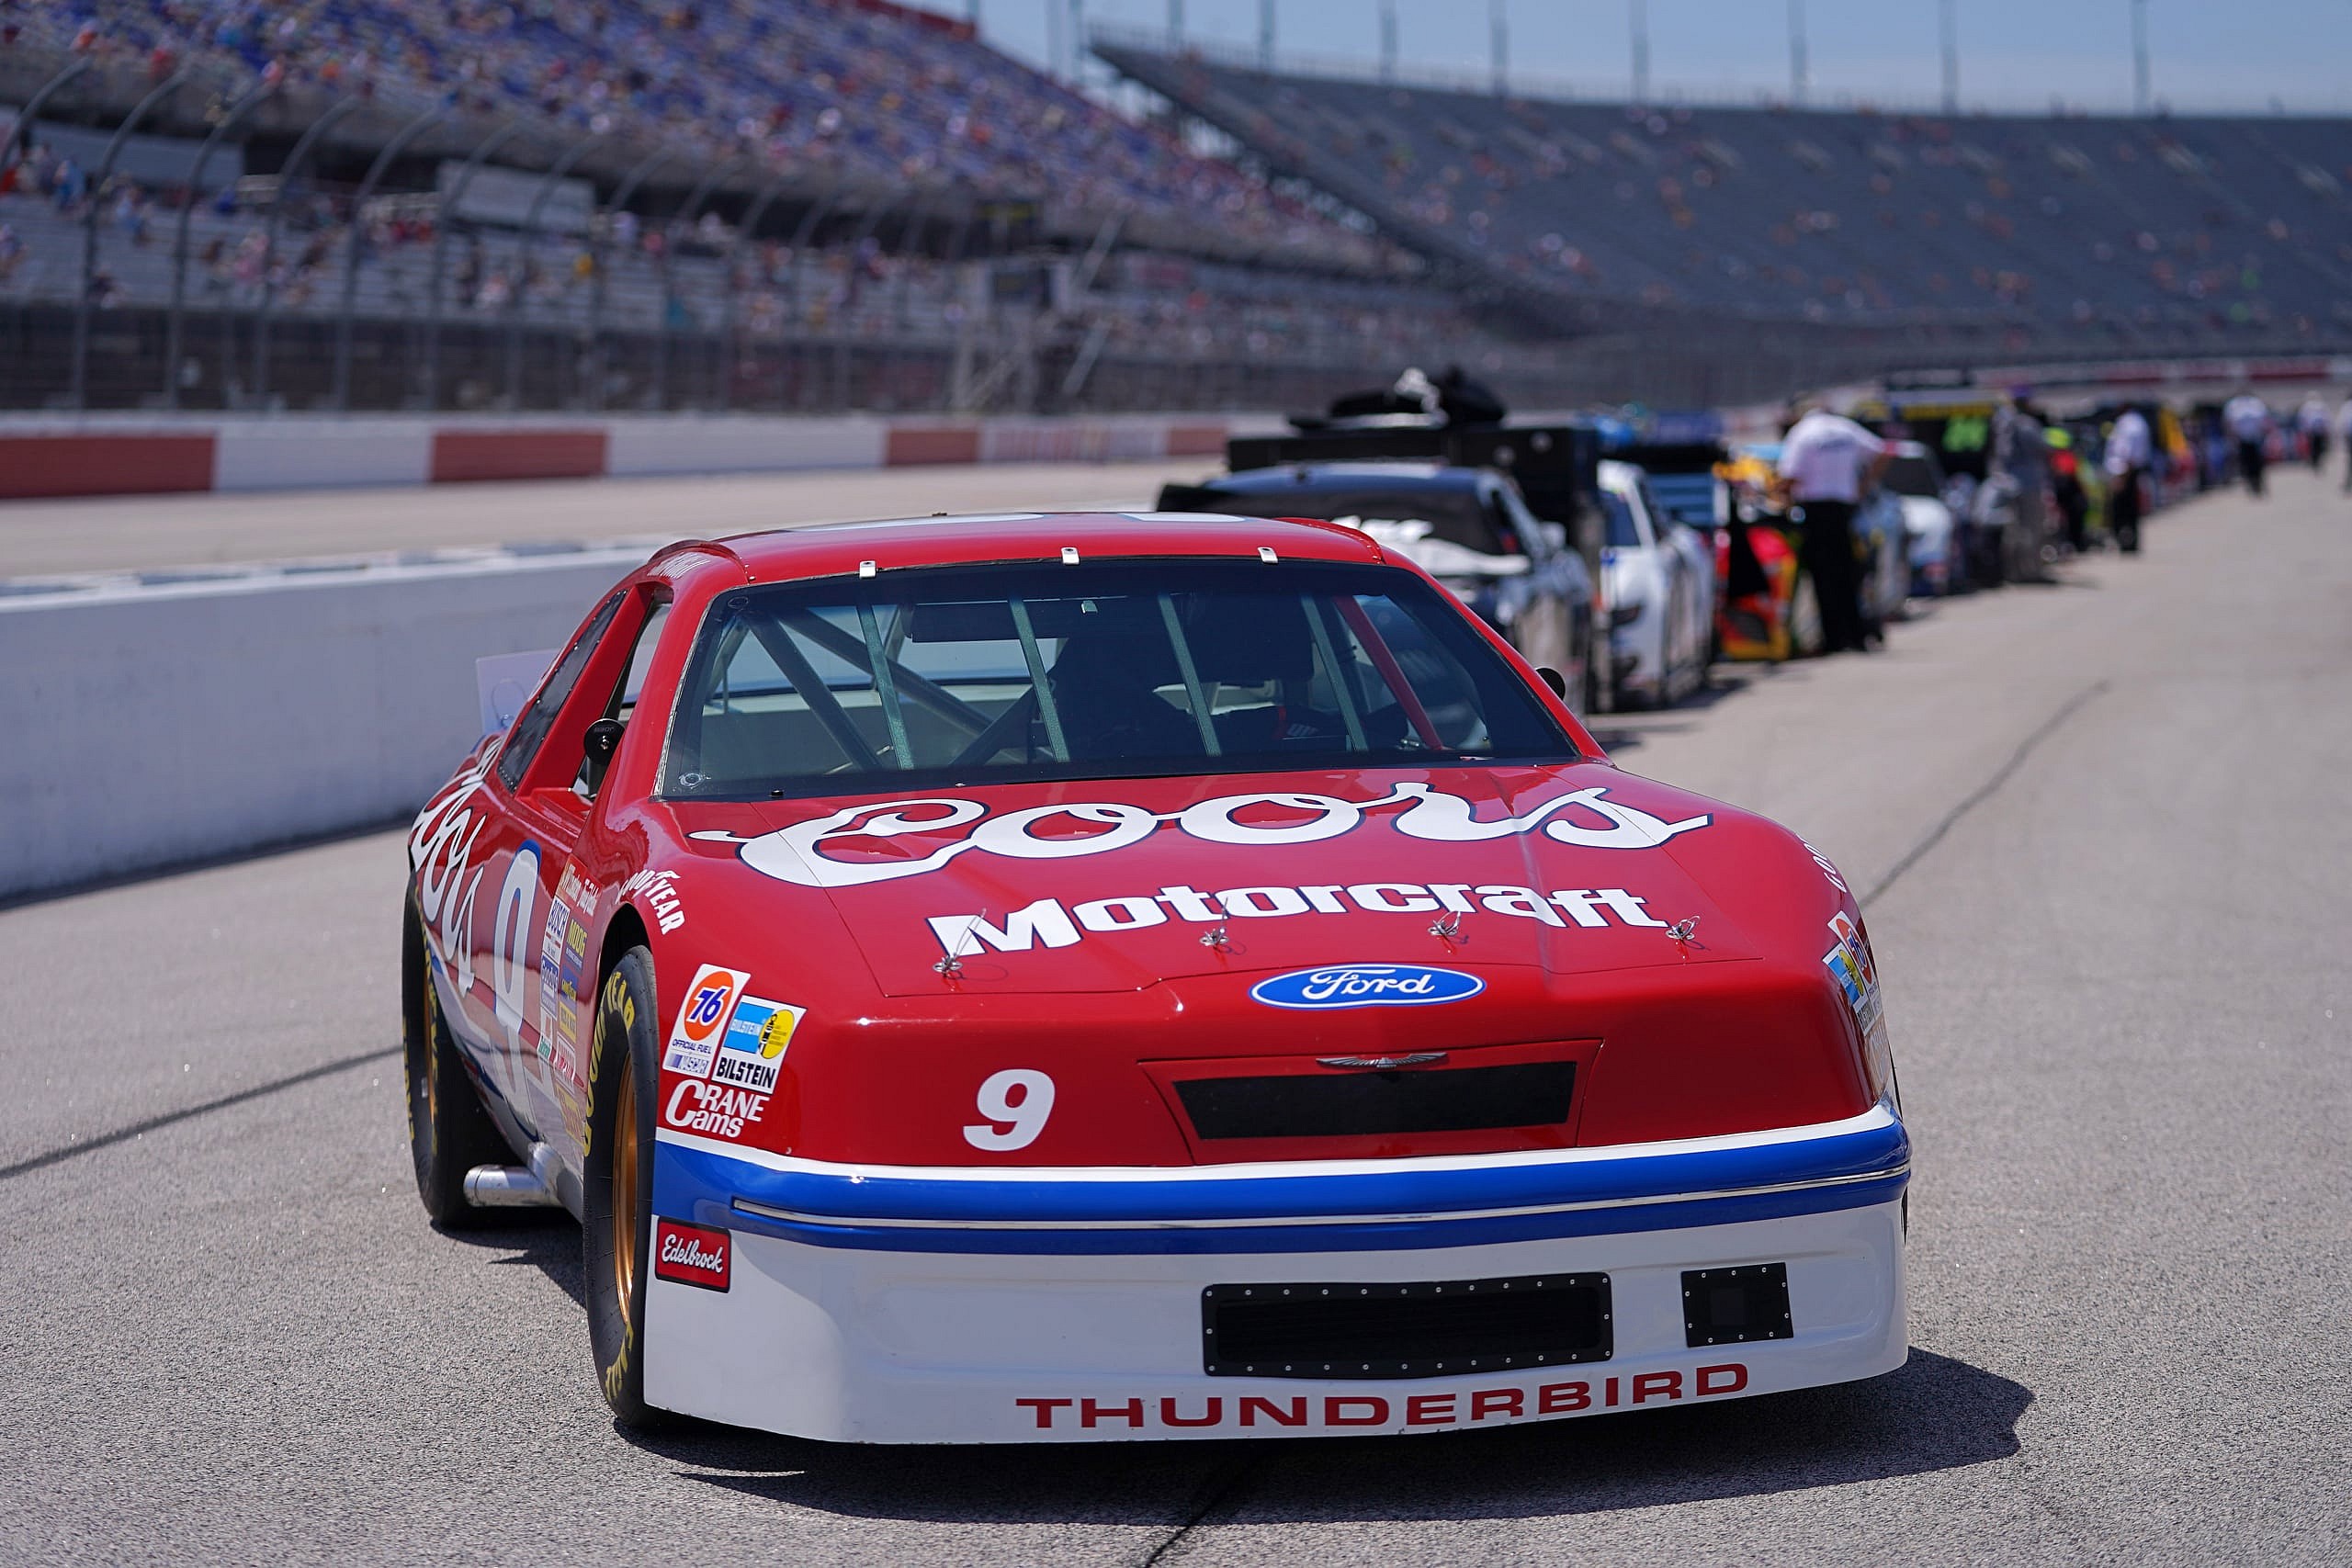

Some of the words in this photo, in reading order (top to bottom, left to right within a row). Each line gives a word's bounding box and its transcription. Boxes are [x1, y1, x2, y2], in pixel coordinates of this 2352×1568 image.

[688, 782, 1713, 889] Coors
[926, 881, 1668, 960] Motorcraft
[687, 987, 729, 1025] 76
[1302, 969, 1435, 1000] Ford
[672, 1038, 696, 1051] OFFICIAL
[697, 1043, 712, 1055] FUEL
[716, 1056, 777, 1089] BILSTEIN
[665, 1078, 771, 1128] CRANE
[964, 1069, 1057, 1153] 9
[662, 1234, 723, 1273] Edelbrock
[1015, 1362, 1749, 1430] THUNDERBIRD
